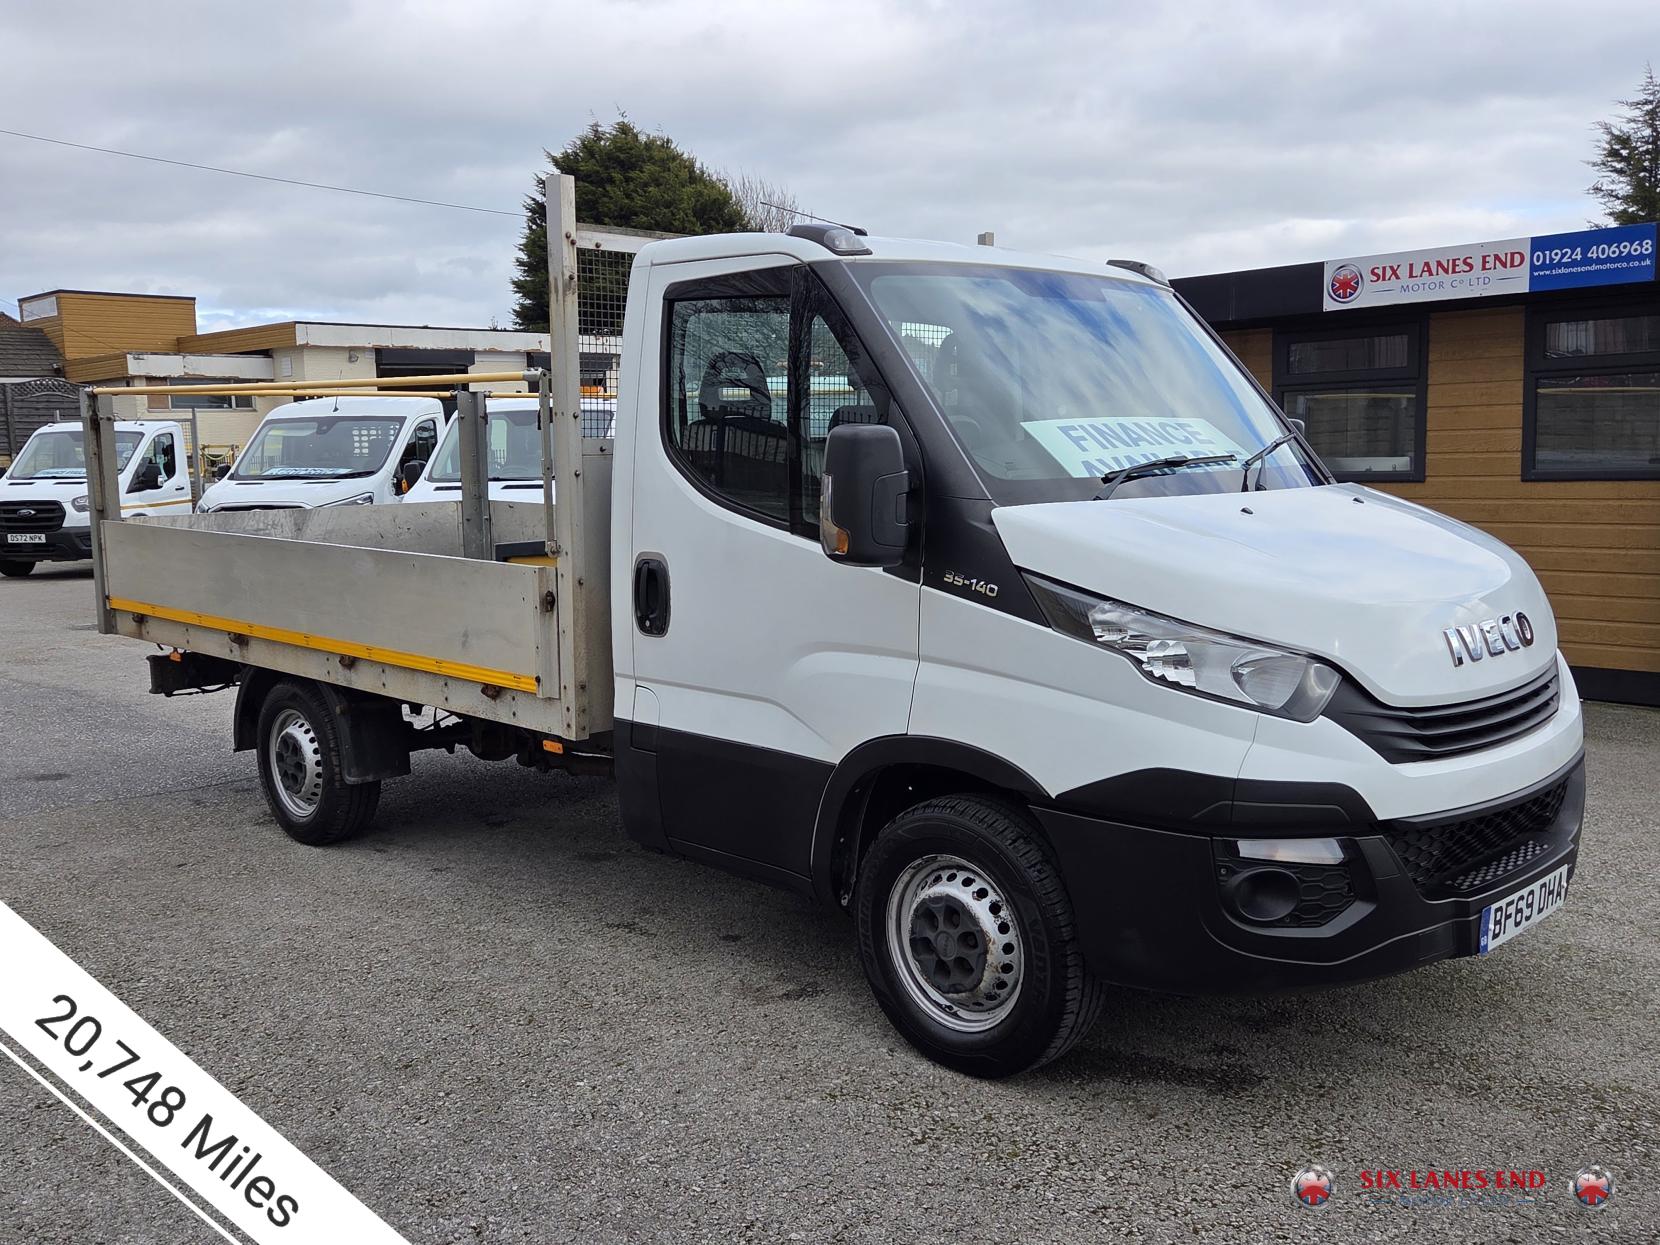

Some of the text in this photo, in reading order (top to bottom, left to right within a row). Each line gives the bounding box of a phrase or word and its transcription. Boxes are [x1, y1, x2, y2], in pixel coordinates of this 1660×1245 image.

[1370, 251, 1526, 283] SIX LANES END
[1533, 239, 1652, 265] 01924 406968
[1533, 258, 1652, 276] www.sixlanesendmotorco.co.uk
[1400, 280, 1445, 294] MOTOR
[1469, 276, 1491, 287] LTD
[1056, 421, 1216, 453] FINANCE
[943, 569, 999, 597] 35-140
[1443, 611, 1535, 667] IVECO
[1491, 871, 1563, 941] BF69 DHA
